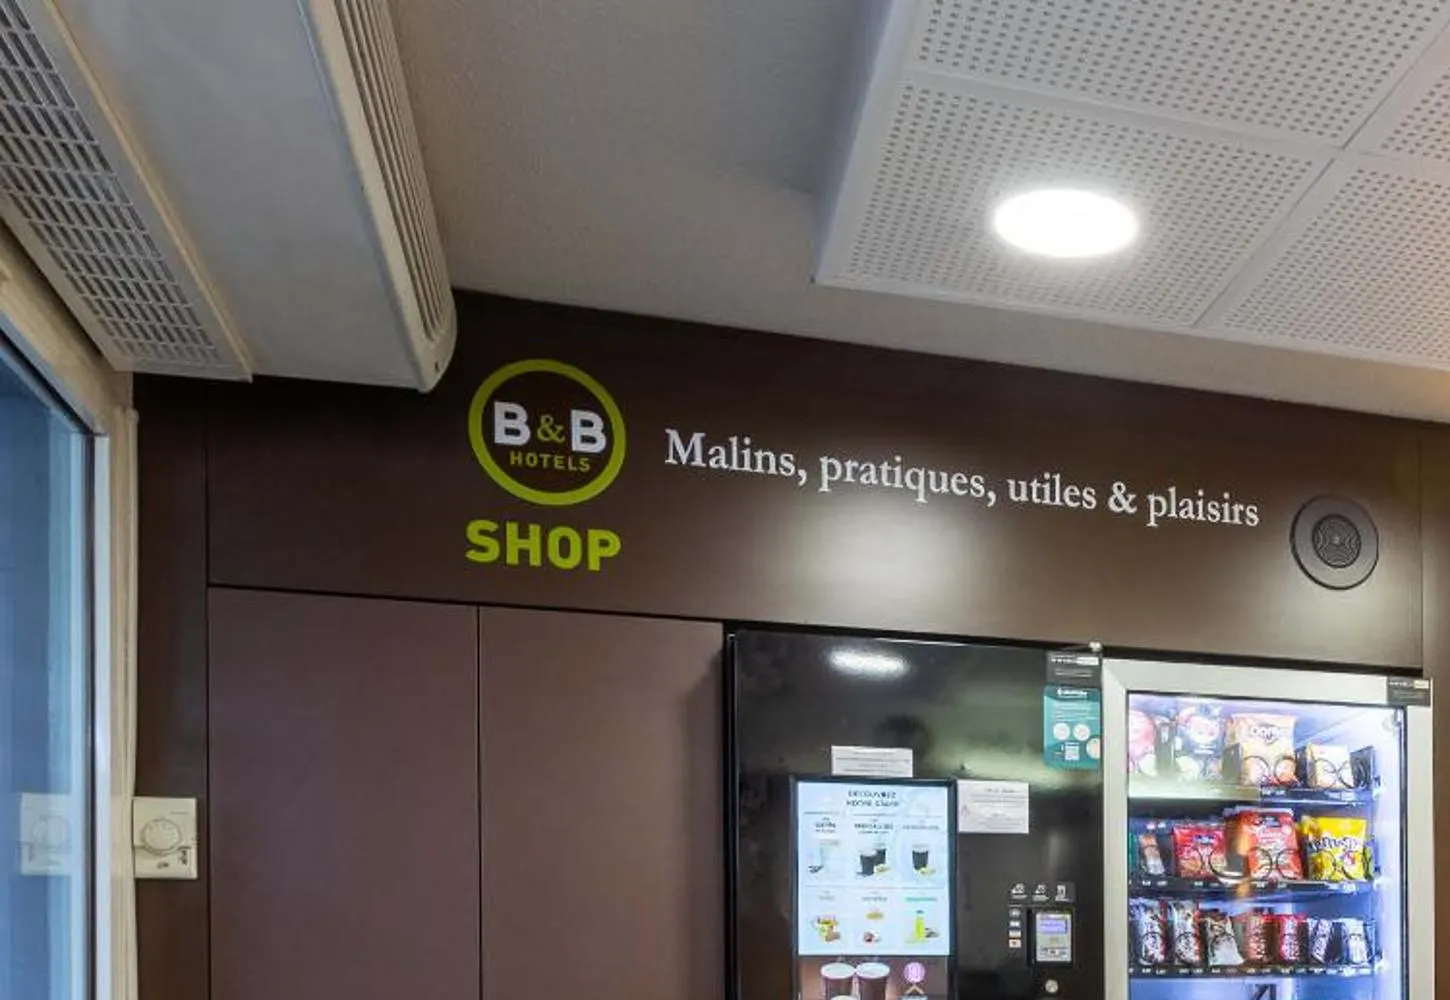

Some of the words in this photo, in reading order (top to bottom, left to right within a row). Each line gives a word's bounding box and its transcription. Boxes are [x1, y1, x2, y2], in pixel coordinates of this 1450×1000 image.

[494, 401, 607, 454] B&B
[509, 450, 591, 473] HOTELS
[665, 429, 807, 486] Malins,
[819, 456, 996, 507] pratiques,
[1007, 473, 1097, 509] utiles
[1108, 482, 1137, 513] &
[1147, 487, 1260, 527] plaisirs
[465, 519, 621, 573] SHOP
